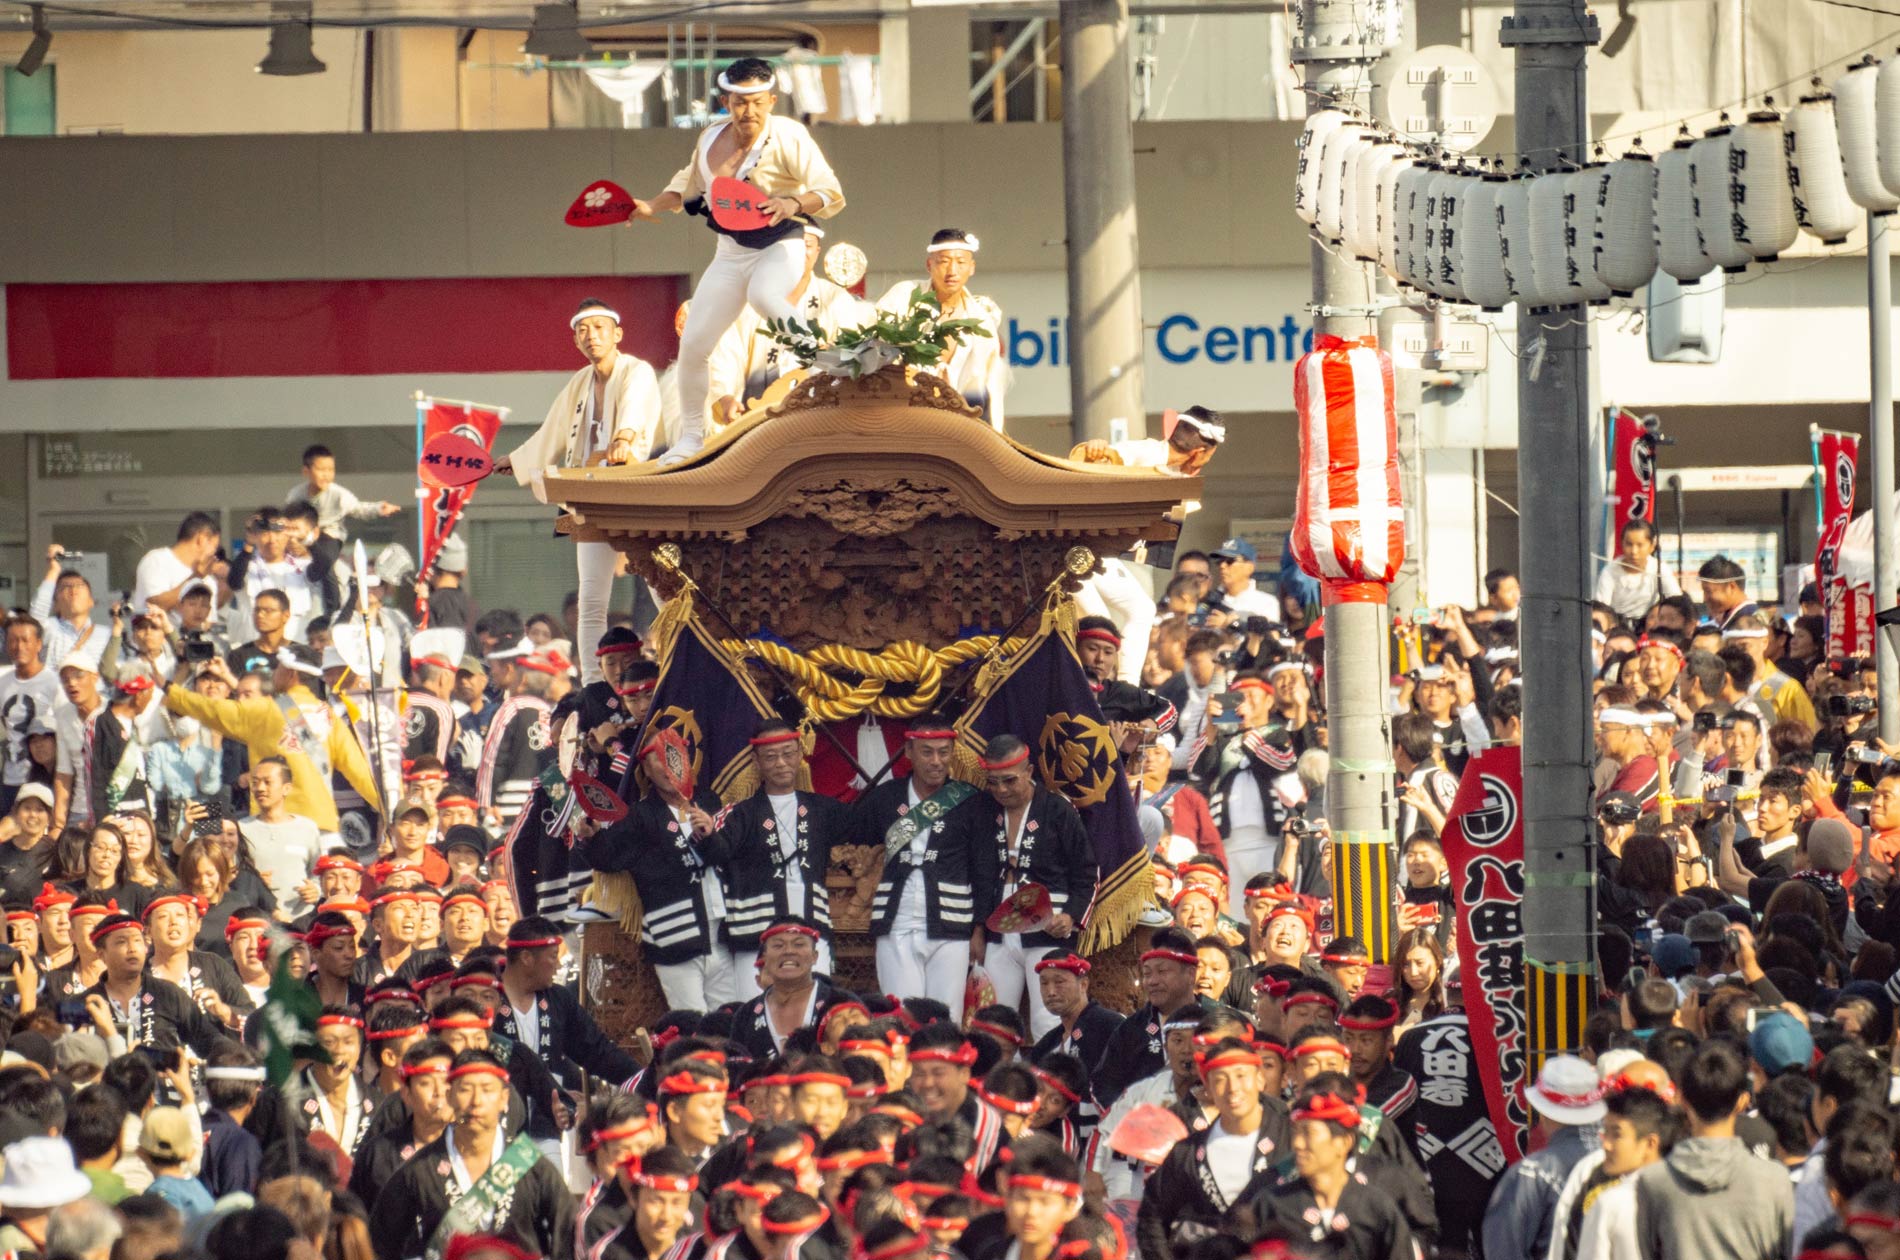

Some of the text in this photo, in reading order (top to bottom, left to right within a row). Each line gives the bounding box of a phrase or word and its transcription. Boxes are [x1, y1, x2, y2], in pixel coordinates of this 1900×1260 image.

[766, 833, 784, 879] 世話人
[1018, 836, 1035, 884] 世話人
